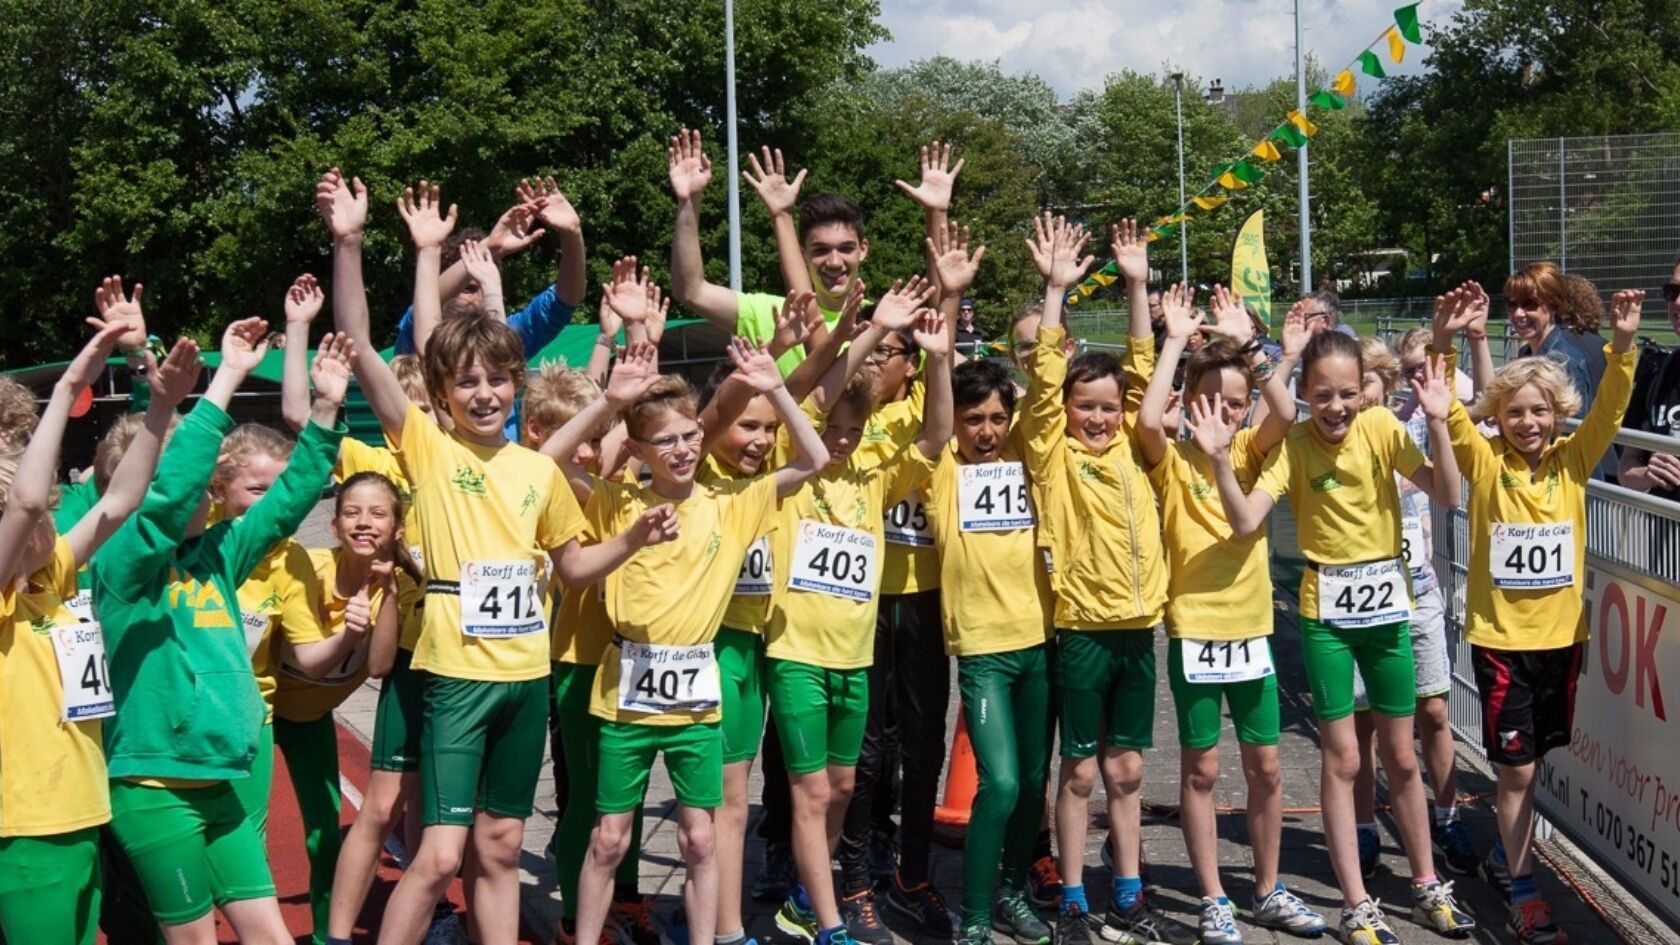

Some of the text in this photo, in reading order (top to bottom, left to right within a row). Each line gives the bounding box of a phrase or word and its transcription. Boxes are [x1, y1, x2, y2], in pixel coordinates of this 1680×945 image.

[975, 466, 1003, 479] Korff
[1005, 466, 1018, 476] de
[974, 484, 1028, 514] 415
[883, 498, 929, 531] 05
[816, 527, 846, 544] Korff
[846, 533, 859, 545] de
[1507, 526, 1535, 540] Korff
[1538, 526, 1551, 537] de
[482, 565, 514, 579] Korff
[516, 564, 528, 576] de
[807, 547, 867, 584] 403
[1336, 567, 1362, 580] Korff
[1366, 566, 1377, 577] de
[1504, 543, 1562, 574] 401
[478, 584, 537, 619] 412
[1335, 581, 1394, 613] 422
[640, 647, 670, 664] Korff
[671, 650, 685, 661] de
[1198, 639, 1250, 668] 411
[635, 668, 700, 700] 407
[1596, 801, 1623, 850] 070
[1627, 824, 1655, 875] 367
